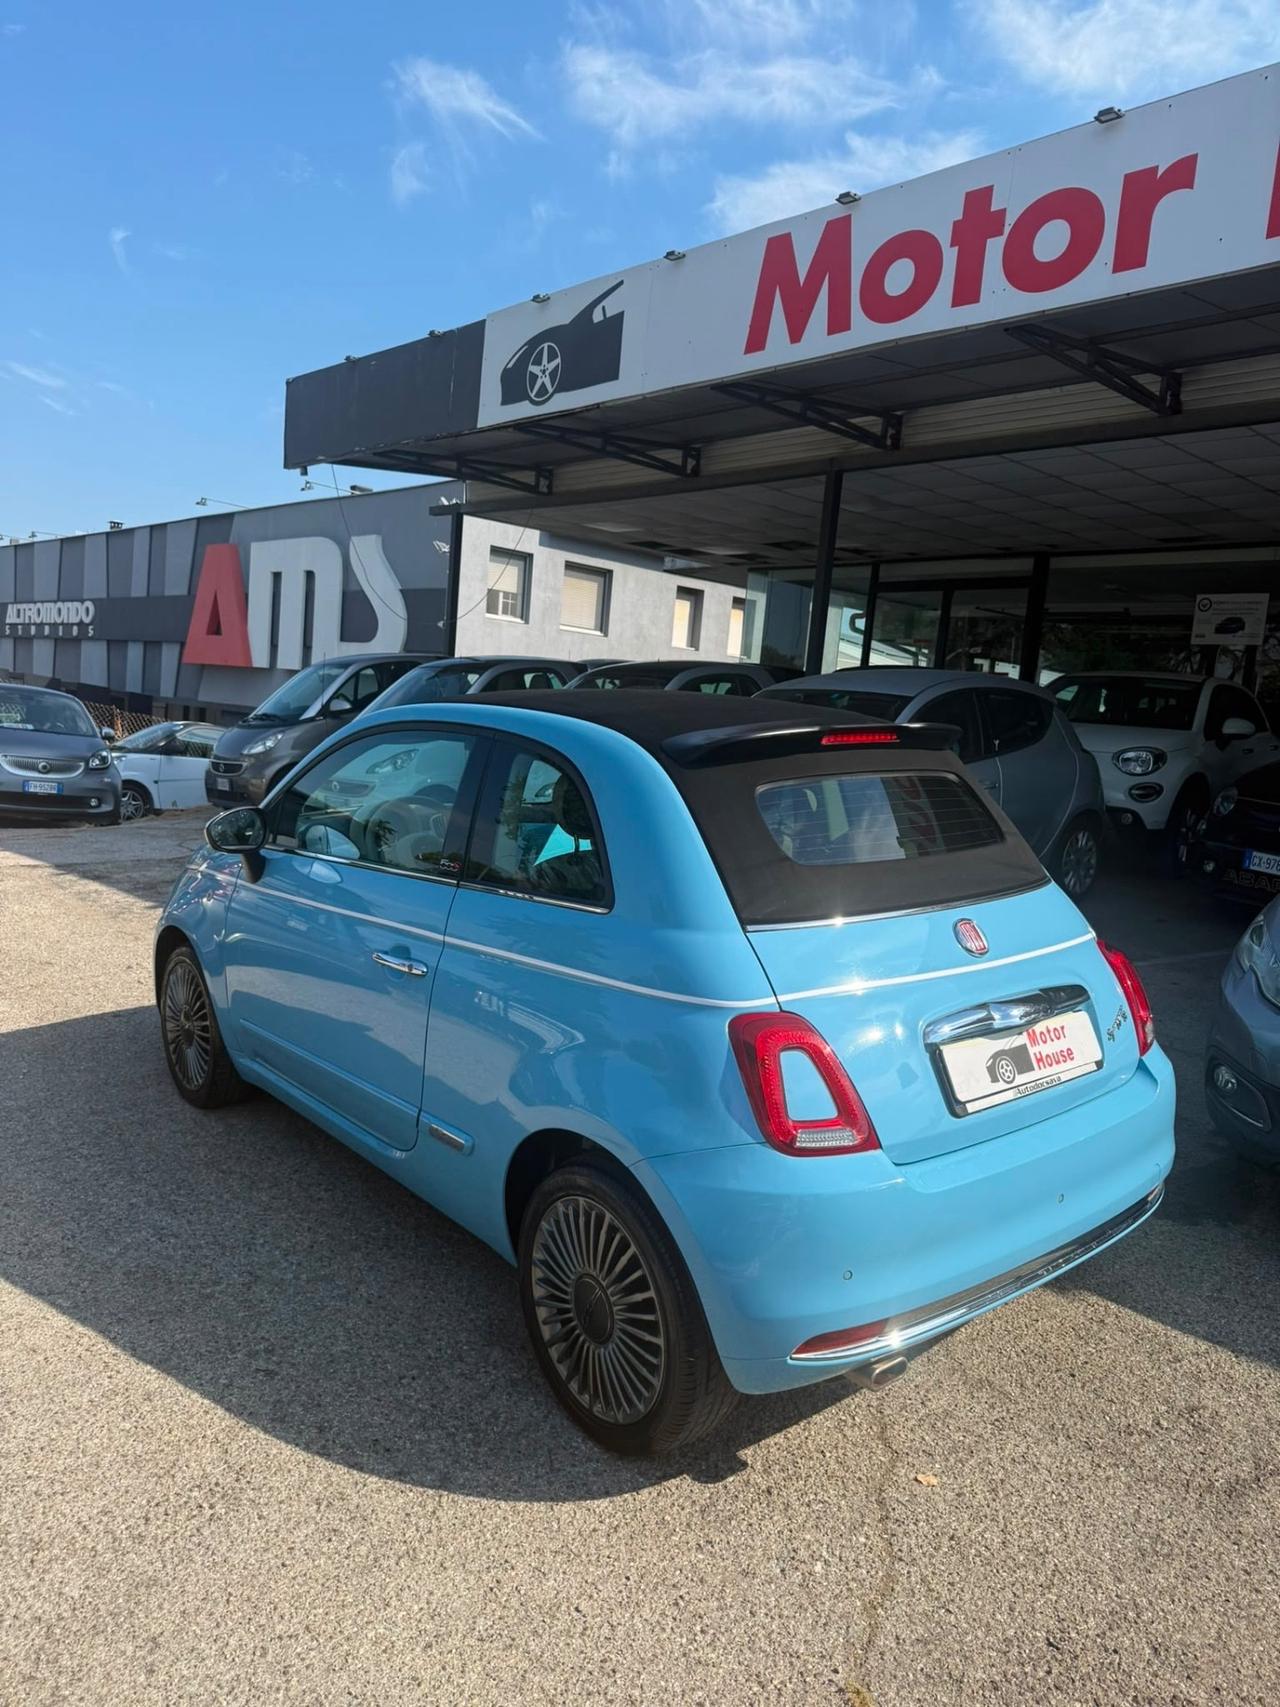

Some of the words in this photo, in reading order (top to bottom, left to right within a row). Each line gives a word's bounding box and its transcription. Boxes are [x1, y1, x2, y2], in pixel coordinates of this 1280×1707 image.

[743, 153, 1198, 355] Motor
[5, 600, 95, 624] ALTROMONDO
[5, 625, 94, 637] STUDIOS
[1026, 1024, 1067, 1048] Motor
[1034, 1047, 1075, 1072] House
